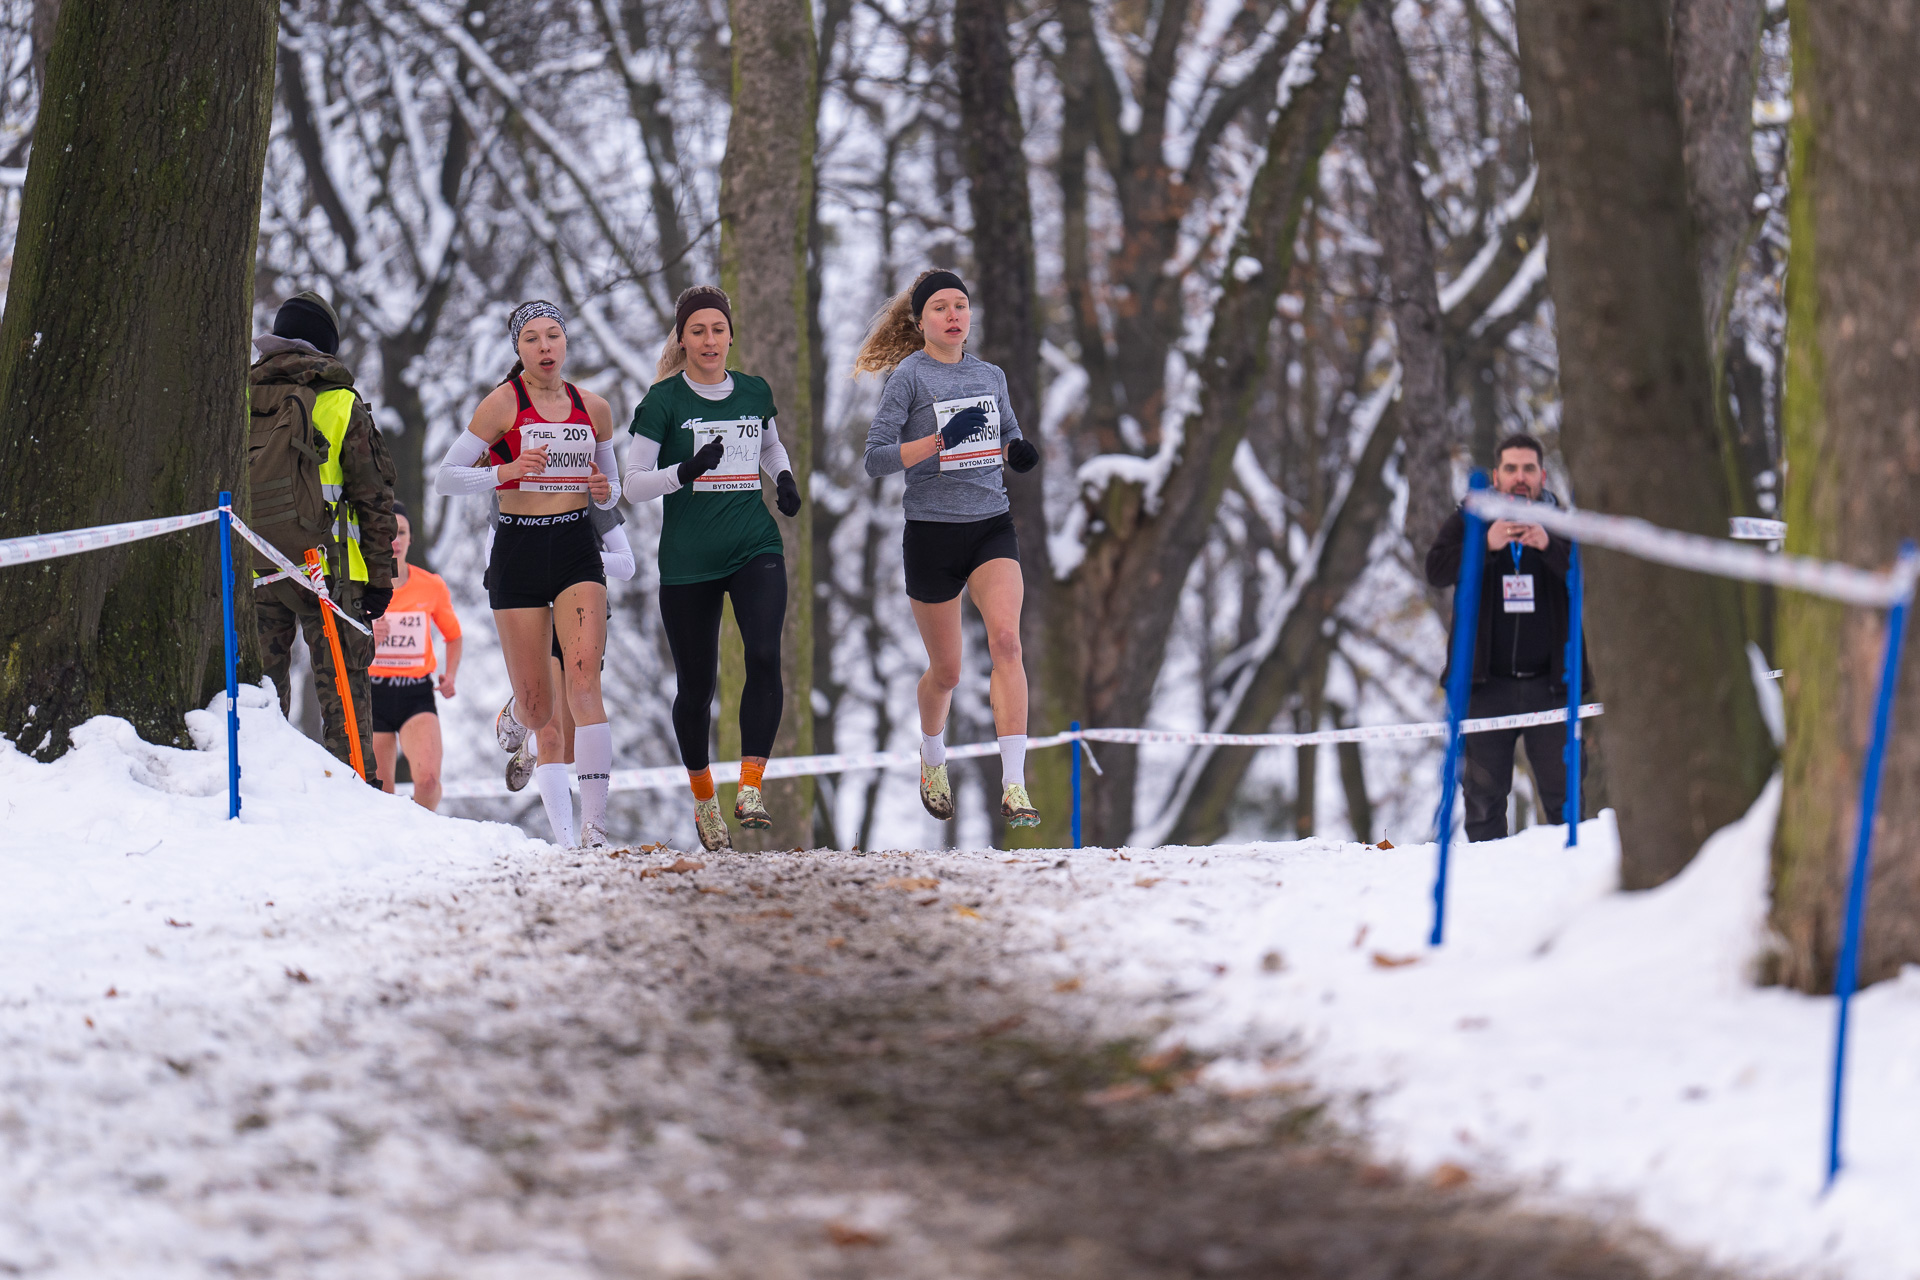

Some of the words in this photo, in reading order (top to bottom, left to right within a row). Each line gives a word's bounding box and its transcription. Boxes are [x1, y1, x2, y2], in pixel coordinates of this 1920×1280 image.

[532, 431, 556, 439] FUEL
[563, 428, 588, 441] 209
[736, 424, 759, 438] 705
[546, 449, 592, 468] ÓRKOWSKA
[959, 460, 982, 468] BYTOM
[516, 517, 551, 526] NIKE
[551, 512, 579, 525] PRO
[399, 616, 421, 627] 421
[379, 635, 416, 647] REZA
